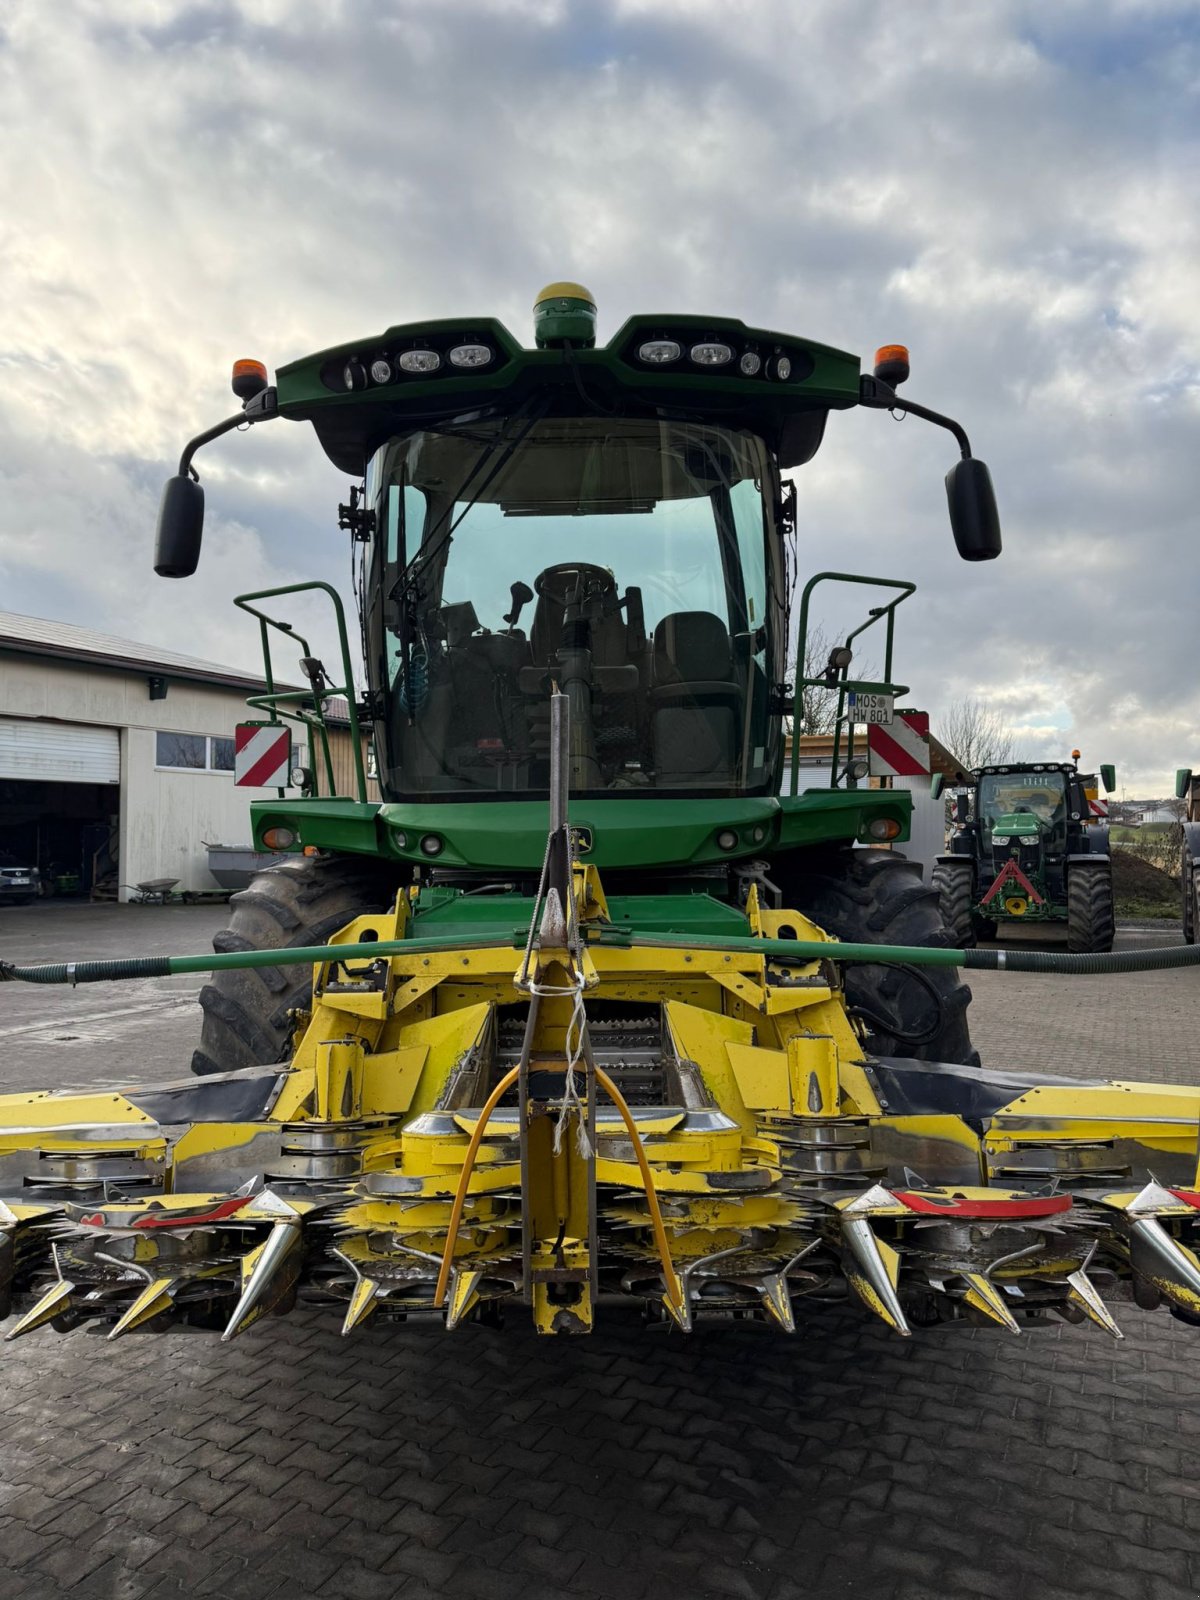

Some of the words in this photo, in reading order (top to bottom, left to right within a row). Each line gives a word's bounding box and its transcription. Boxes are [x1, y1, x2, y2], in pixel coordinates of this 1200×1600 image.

[856, 694, 877, 708] MOS
[853, 708, 867, 722] HW
[870, 709, 889, 723] 801
